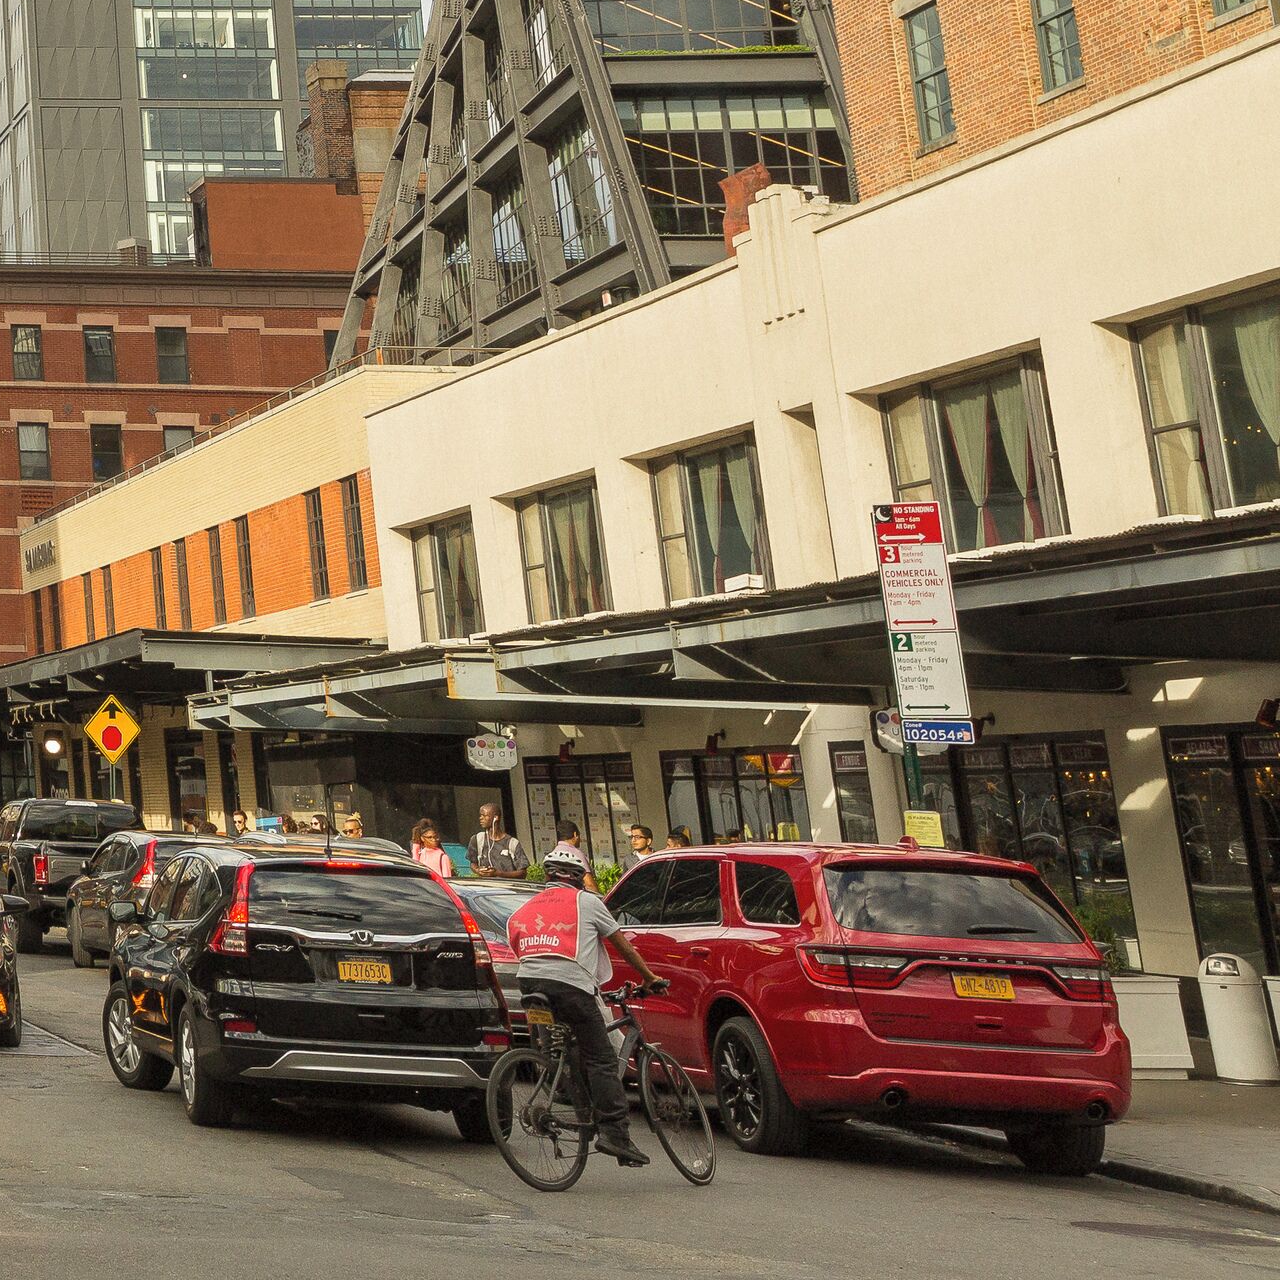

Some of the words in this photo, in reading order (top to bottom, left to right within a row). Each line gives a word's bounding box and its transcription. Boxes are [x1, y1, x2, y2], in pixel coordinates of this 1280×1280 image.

[904, 505, 935, 514] STANDING
[884, 546, 896, 563] 3
[885, 569, 938, 578] COMMERCIAL
[886, 579, 923, 588] VEHICLES
[925, 578, 944, 587] ONLY
[887, 592, 911, 600] Monday
[896, 634, 909, 651] 2
[928, 656, 949, 664] Friday
[906, 729, 956, 740] 102054
[340, 962, 387, 979] T737653C
